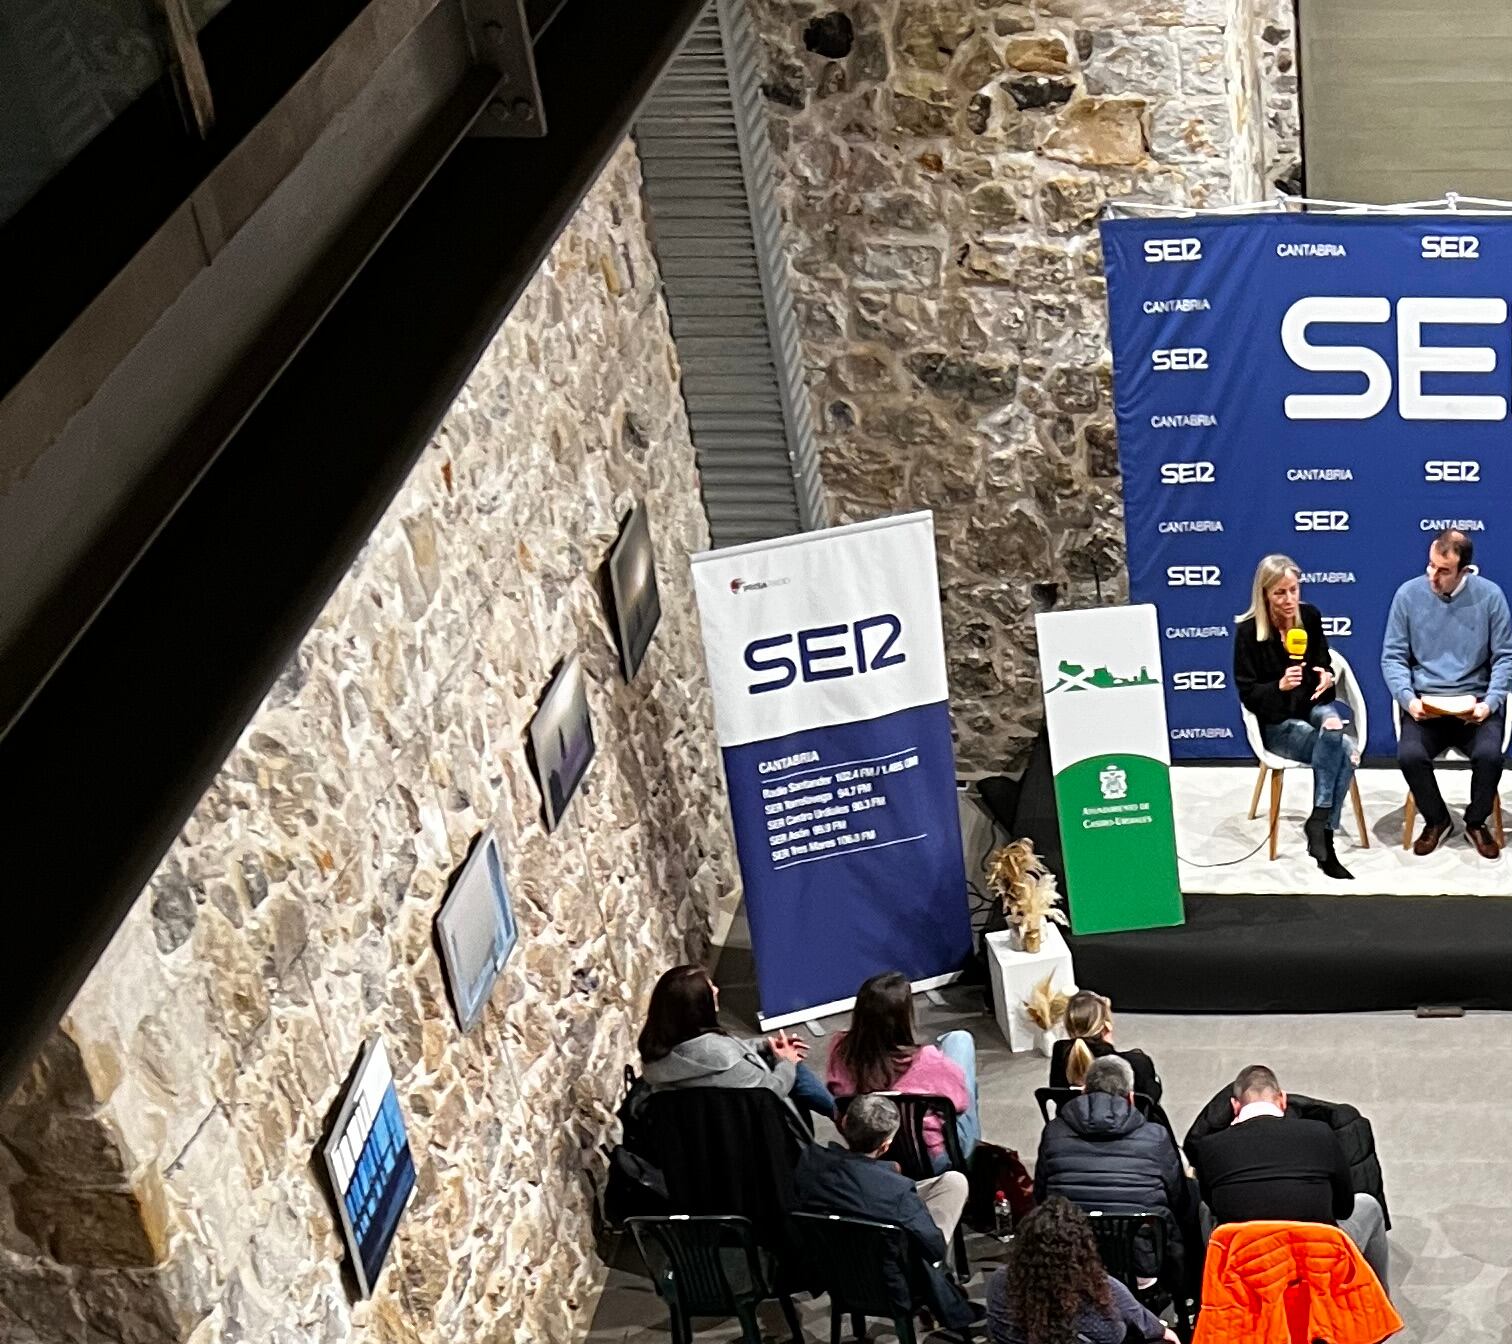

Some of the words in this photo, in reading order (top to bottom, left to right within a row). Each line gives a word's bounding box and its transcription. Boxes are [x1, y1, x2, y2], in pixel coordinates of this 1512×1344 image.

[1143, 237, 1202, 263] SER
[1276, 243, 1347, 257] CANTABRIA
[1421, 235, 1480, 259] SER
[1143, 298, 1211, 314] CANTABRIA
[1151, 347, 1209, 371] SER
[1150, 414, 1217, 428] CANTABRIA
[1160, 461, 1216, 484] SER
[1286, 468, 1354, 481] CANTABRIA
[1424, 460, 1481, 482] SER
[1158, 520, 1224, 533] CANTABRIA
[1294, 510, 1350, 531] SER
[1419, 519, 1485, 531] CANTABRIA
[1166, 565, 1221, 586] SER
[1299, 571, 1356, 583] ANTABRIA
[1165, 626, 1229, 639] CANTABRIA
[1320, 616, 1352, 636] ER
[743, 613, 906, 695] SER
[1172, 670, 1227, 691] SER
[1170, 727, 1234, 740] CANTABRIA
[758, 750, 820, 774] CANTABRIA
